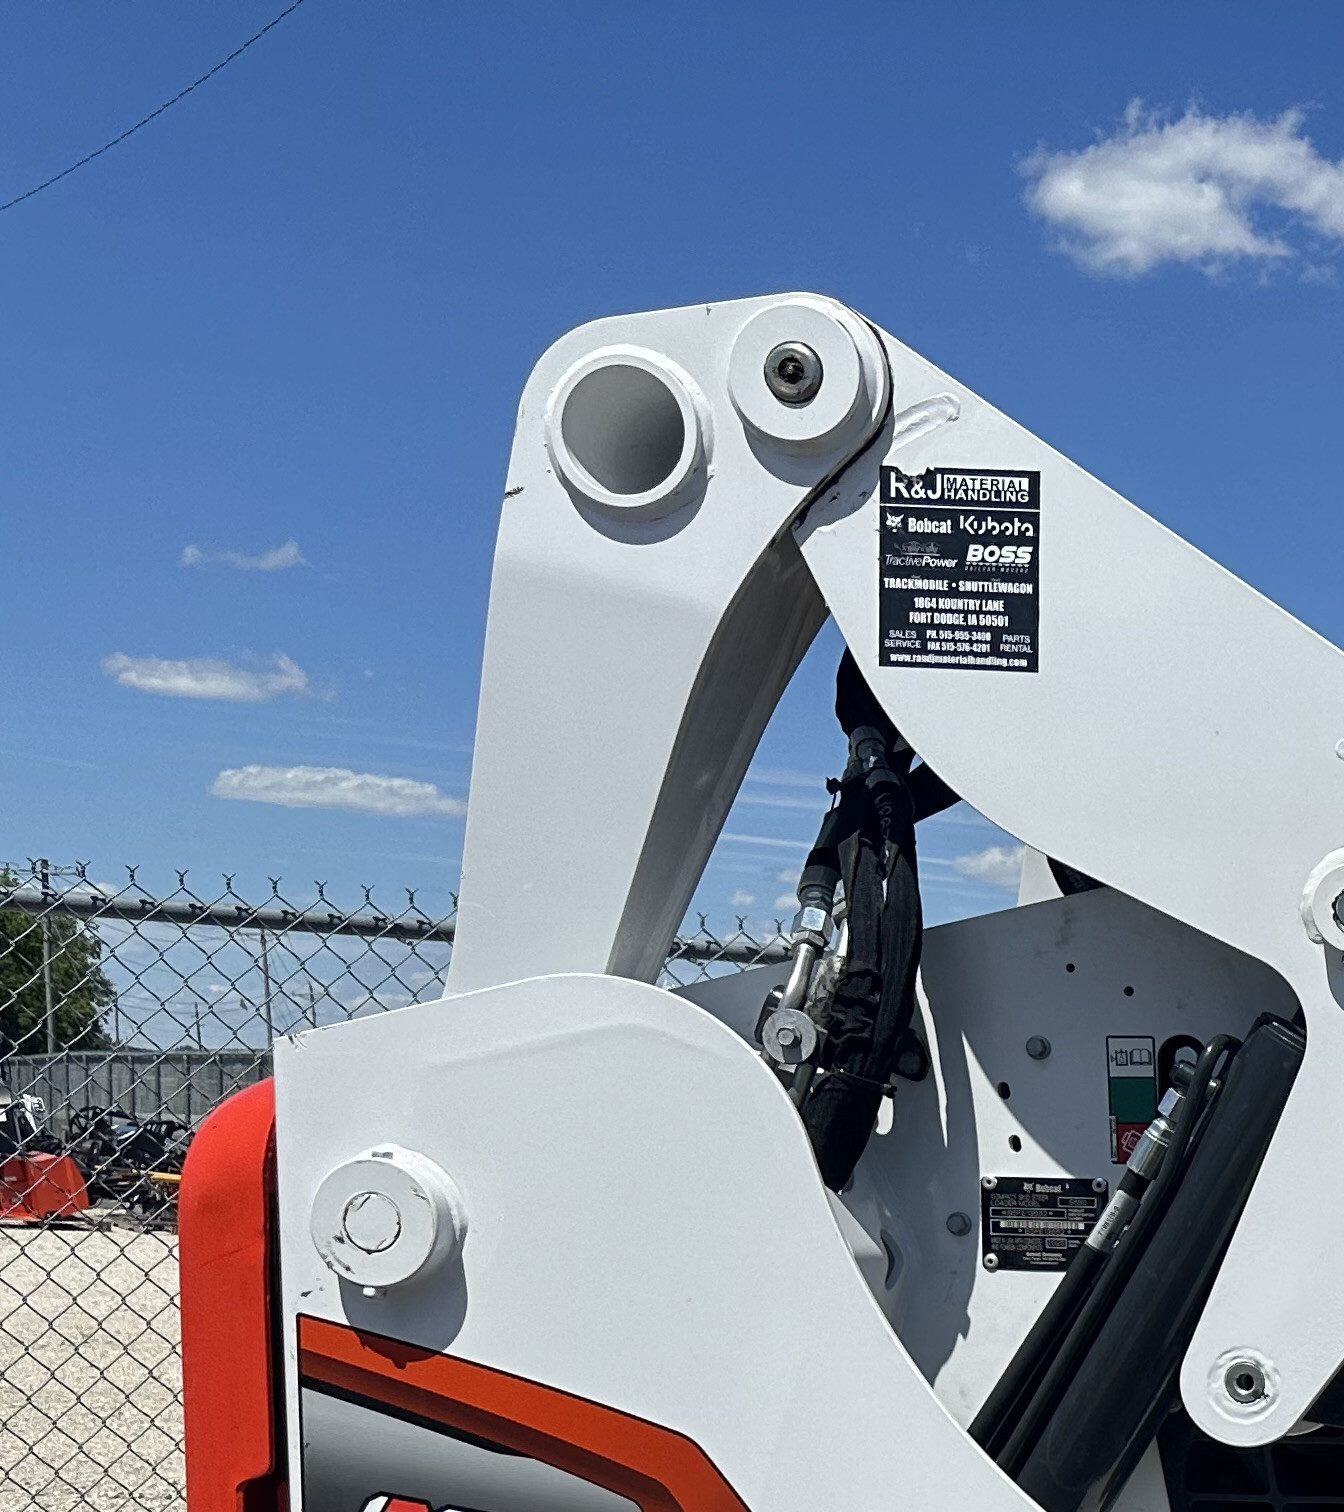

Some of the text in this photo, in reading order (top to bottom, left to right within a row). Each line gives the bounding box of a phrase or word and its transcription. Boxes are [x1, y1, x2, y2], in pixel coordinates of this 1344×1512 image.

[945, 476, 1028, 490] MATERIAL
[944, 490, 1029, 502] HANDLING
[908, 515, 1034, 537] Bobcat Kubota
[885, 544, 1033, 568] TractivePower BOSS
[884, 578, 1033, 594] TRACKMOBILE SHUTTLEWAGON
[938, 598, 980, 611] KOUNTRY
[982, 600, 1004, 612] LANE
[909, 612, 1009, 627] FORT DODGE, IA 50501
[889, 630, 917, 638] SALES
[1002, 634, 1030, 644] PARTS
[885, 639, 921, 648] SERVICE
[1000, 644, 1033, 653] RENTAL
